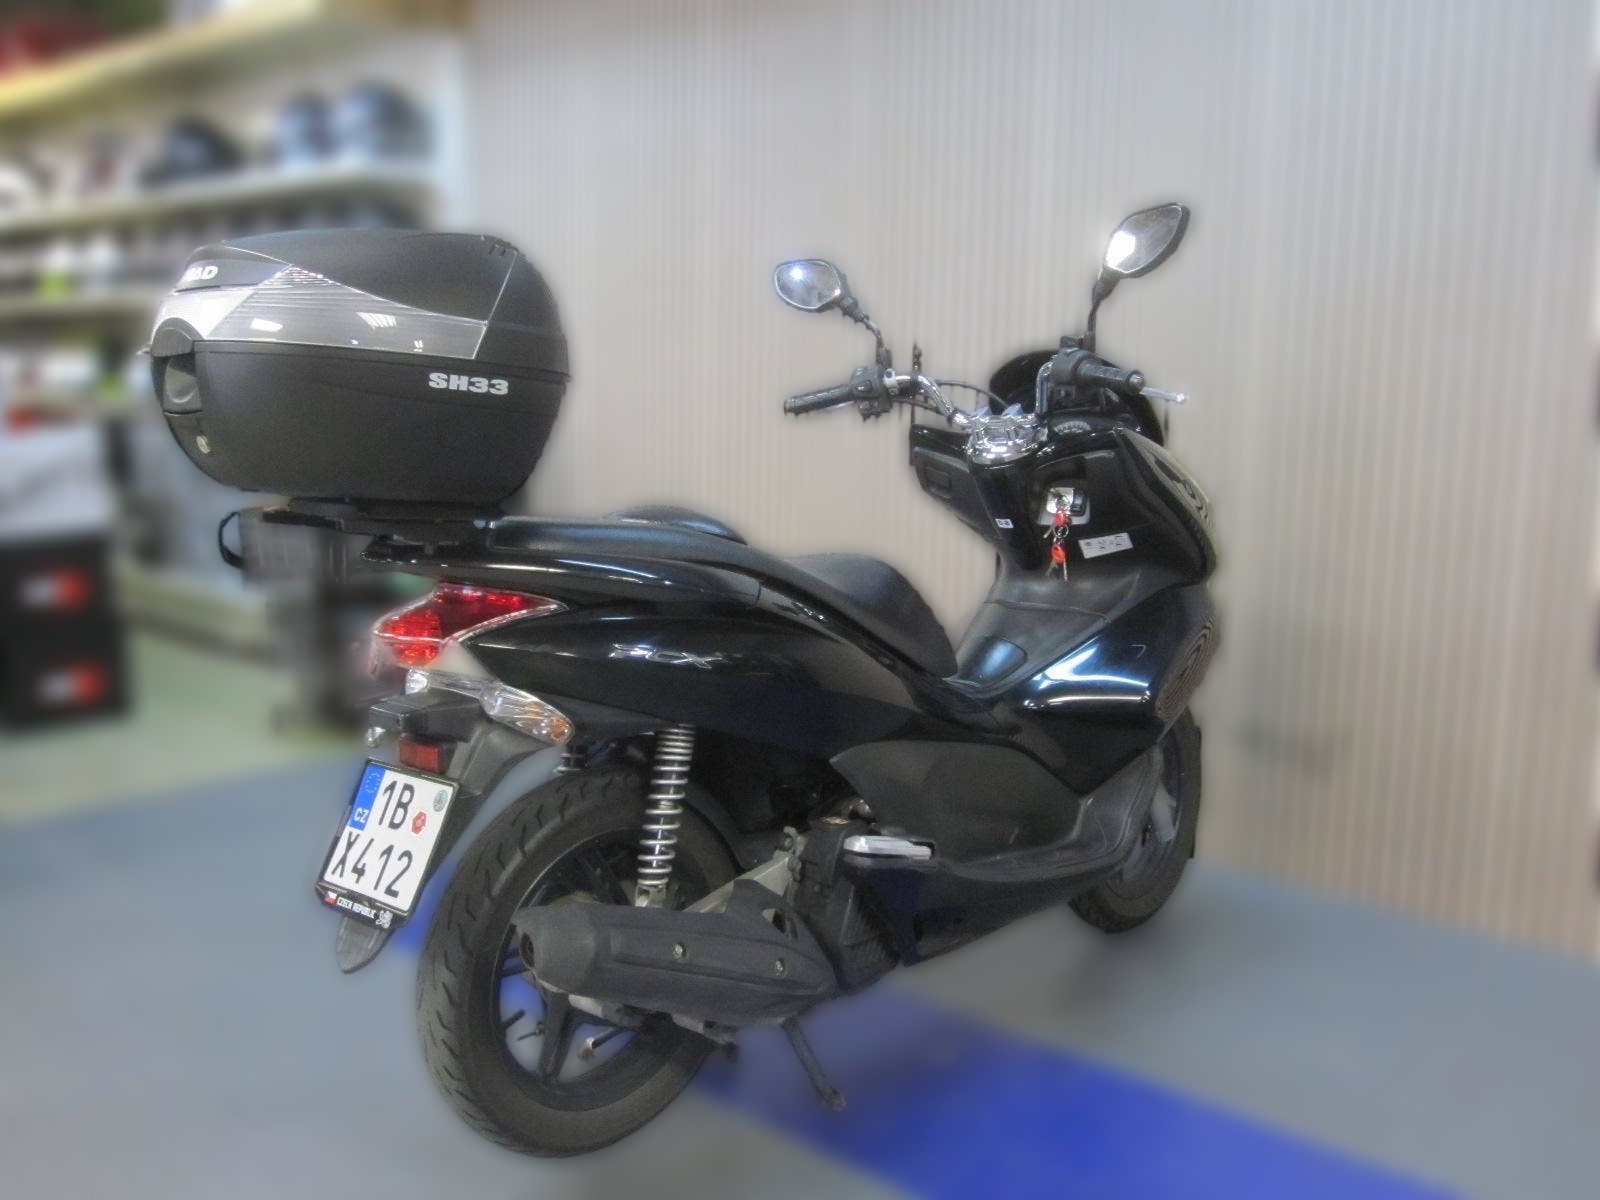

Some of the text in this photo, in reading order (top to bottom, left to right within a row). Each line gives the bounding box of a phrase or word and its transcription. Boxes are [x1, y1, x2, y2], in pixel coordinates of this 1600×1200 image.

[428, 372, 509, 395] SH33
[354, 807, 369, 823] CZ
[378, 780, 415, 830] 1B
[331, 831, 413, 898] X412
